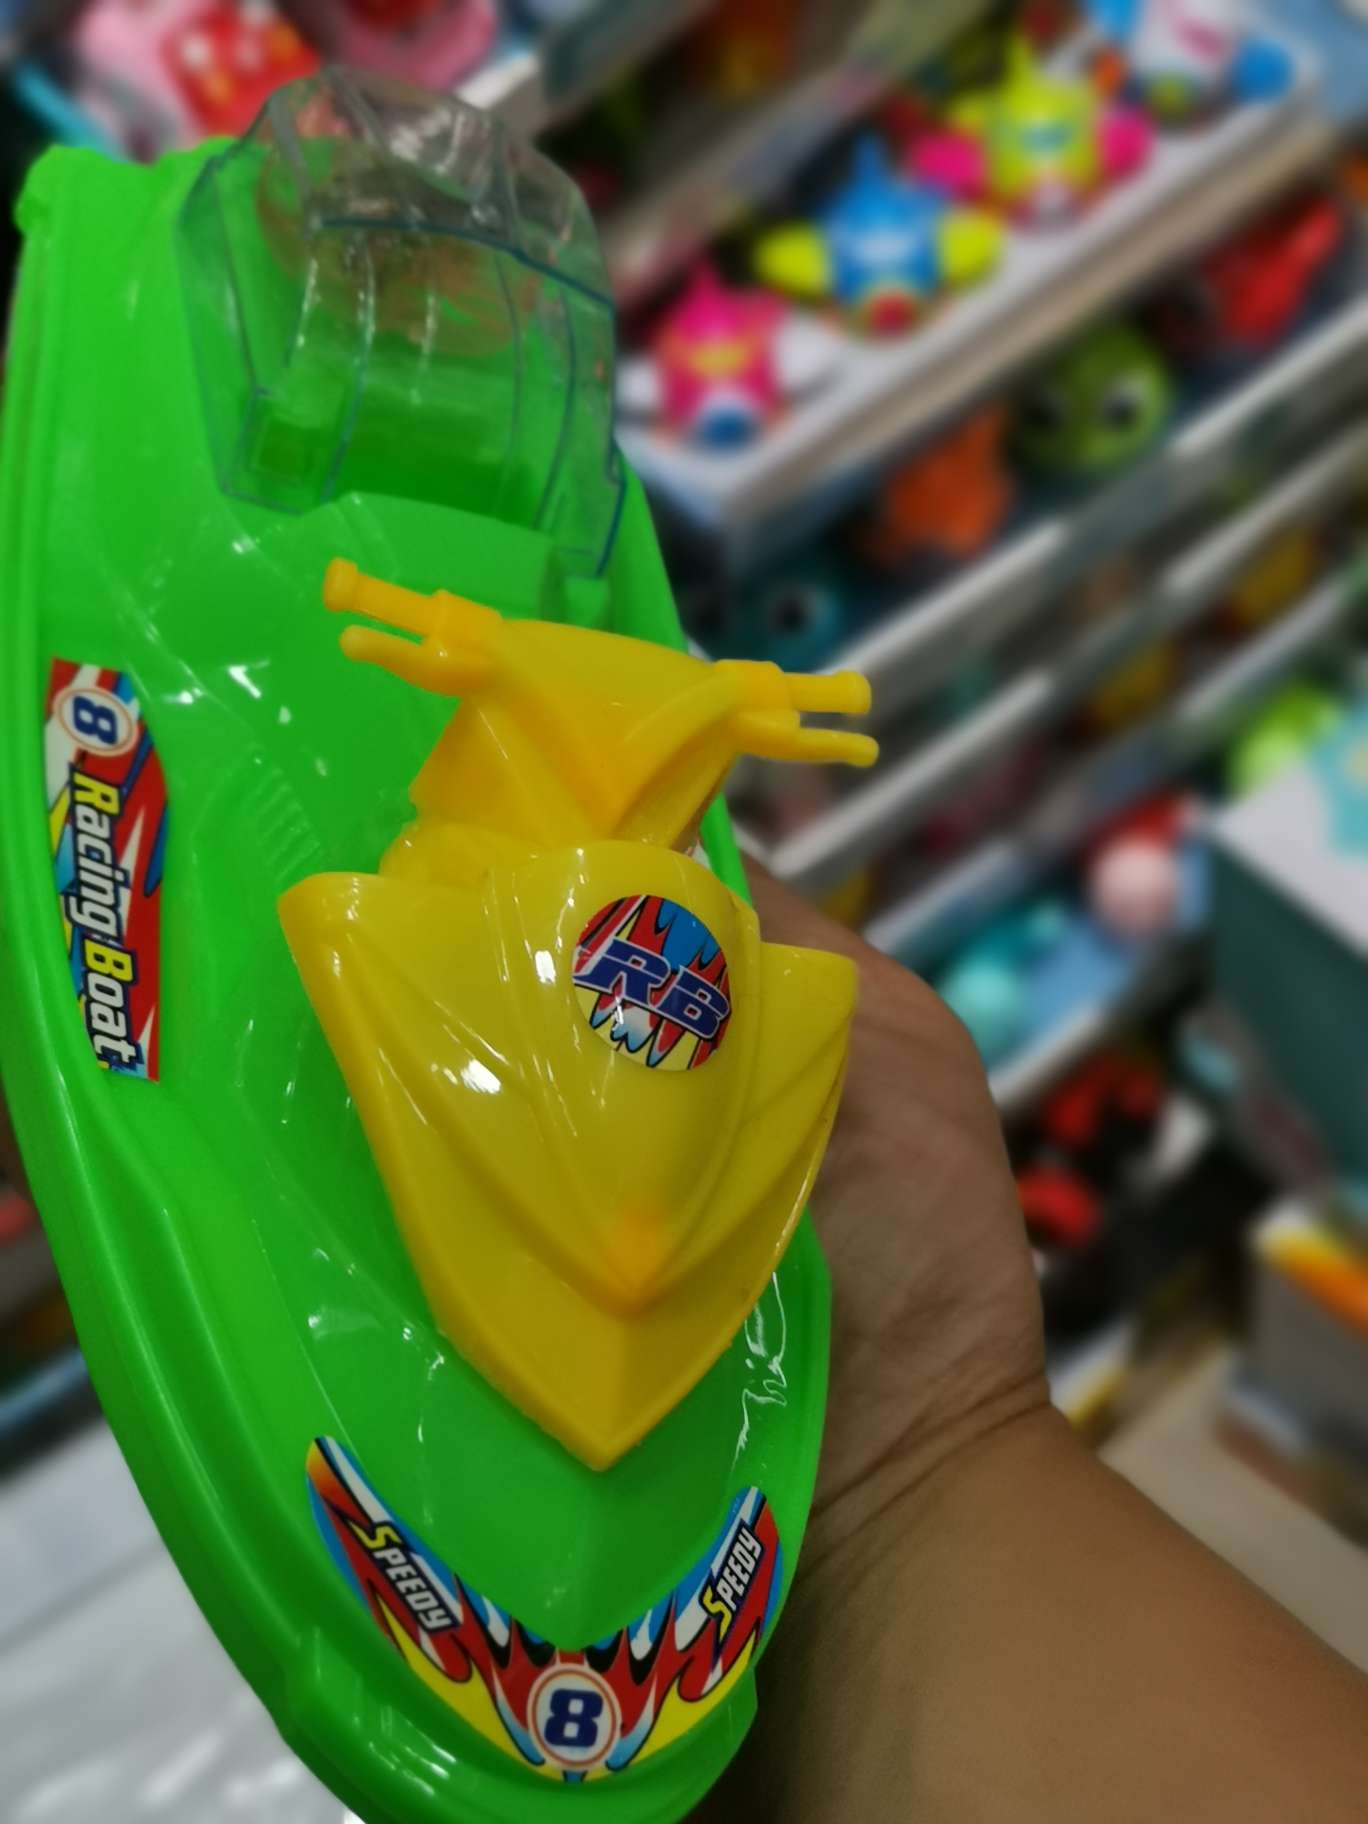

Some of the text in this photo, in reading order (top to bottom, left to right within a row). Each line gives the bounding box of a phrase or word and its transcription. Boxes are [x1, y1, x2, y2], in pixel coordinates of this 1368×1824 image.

[72, 695, 119, 746] 8
[69, 771, 137, 1063] Racing Boat
[572, 935, 730, 1040] RB
[543, 1687, 604, 1748] 8
